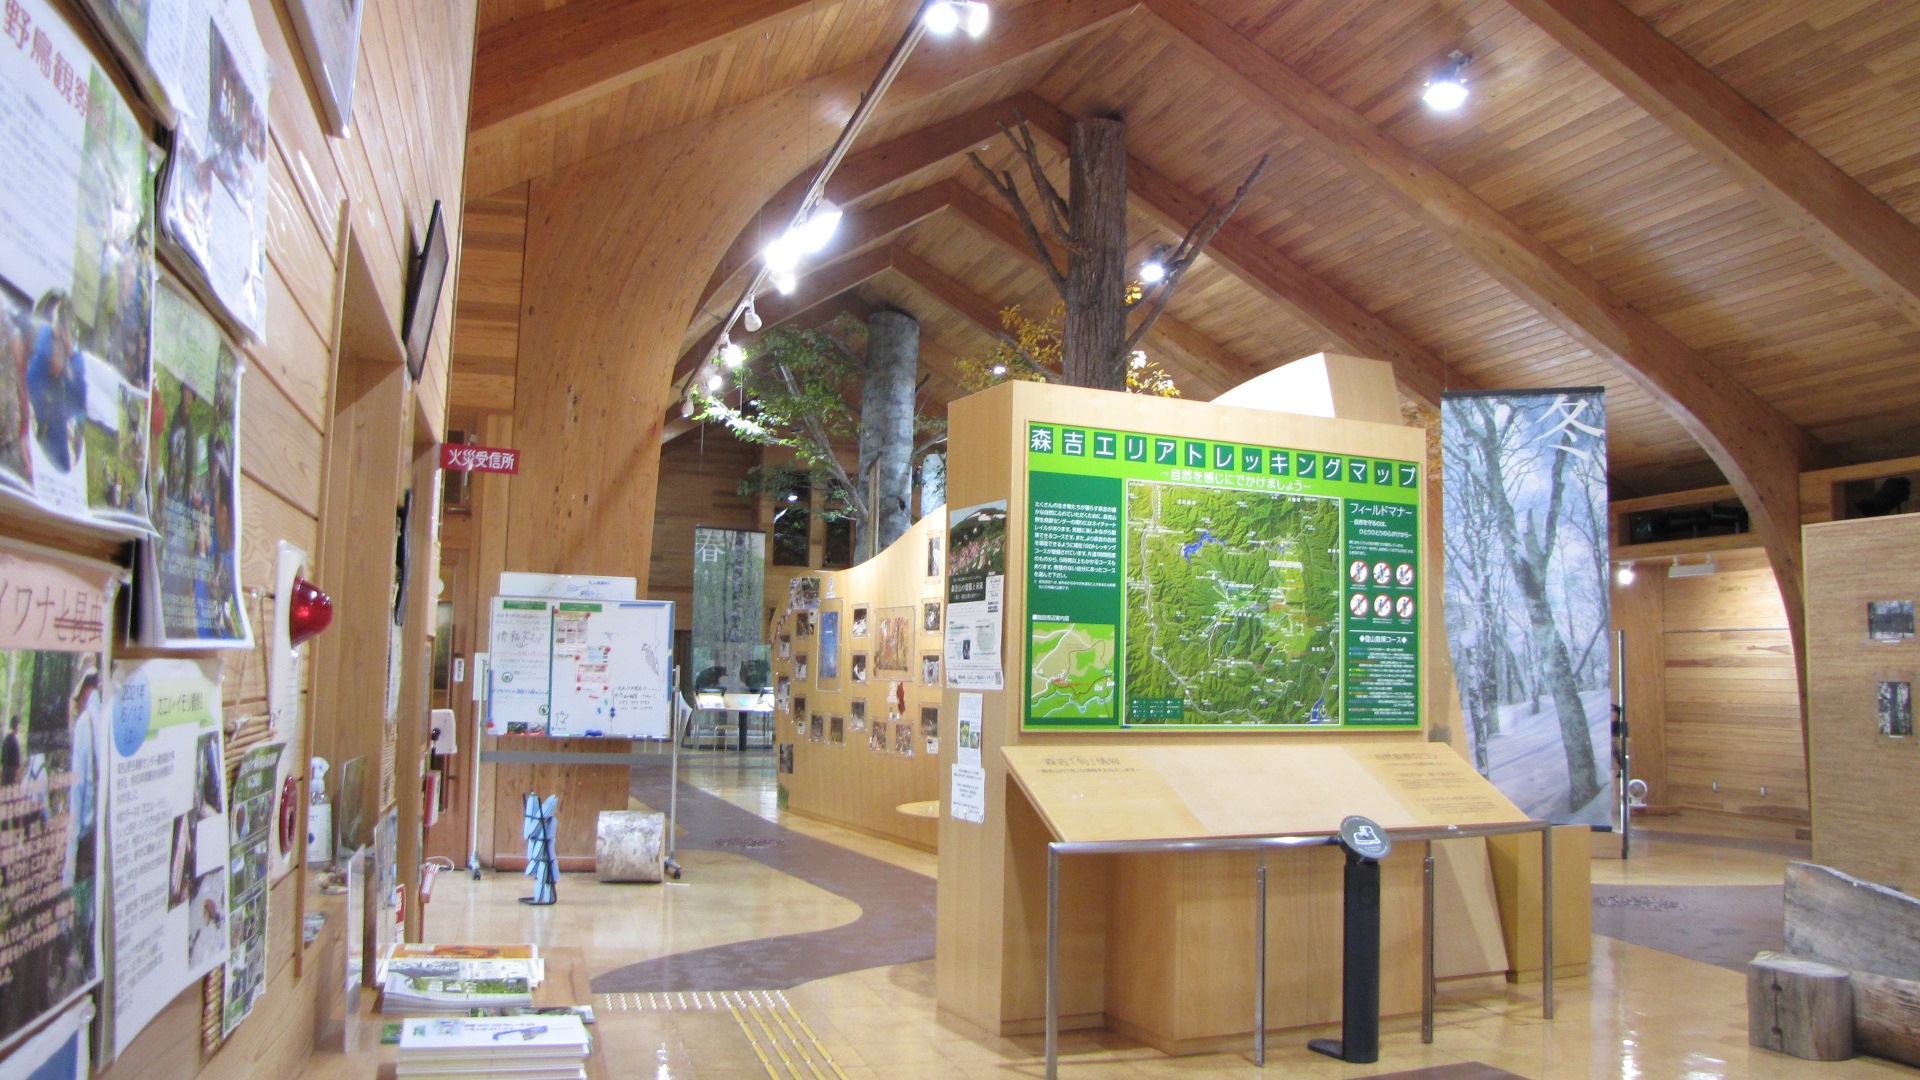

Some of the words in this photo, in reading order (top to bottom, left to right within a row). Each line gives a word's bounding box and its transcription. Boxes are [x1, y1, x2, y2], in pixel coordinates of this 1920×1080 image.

[1533, 394, 1605, 460] 冬
[448, 448, 515, 470] 火災受信所
[1030, 428, 1416, 487] 森吉エリアトレッキングマップ
[1349, 503, 1413, 518] フィールドマナー
[695, 530, 725, 563] 春
